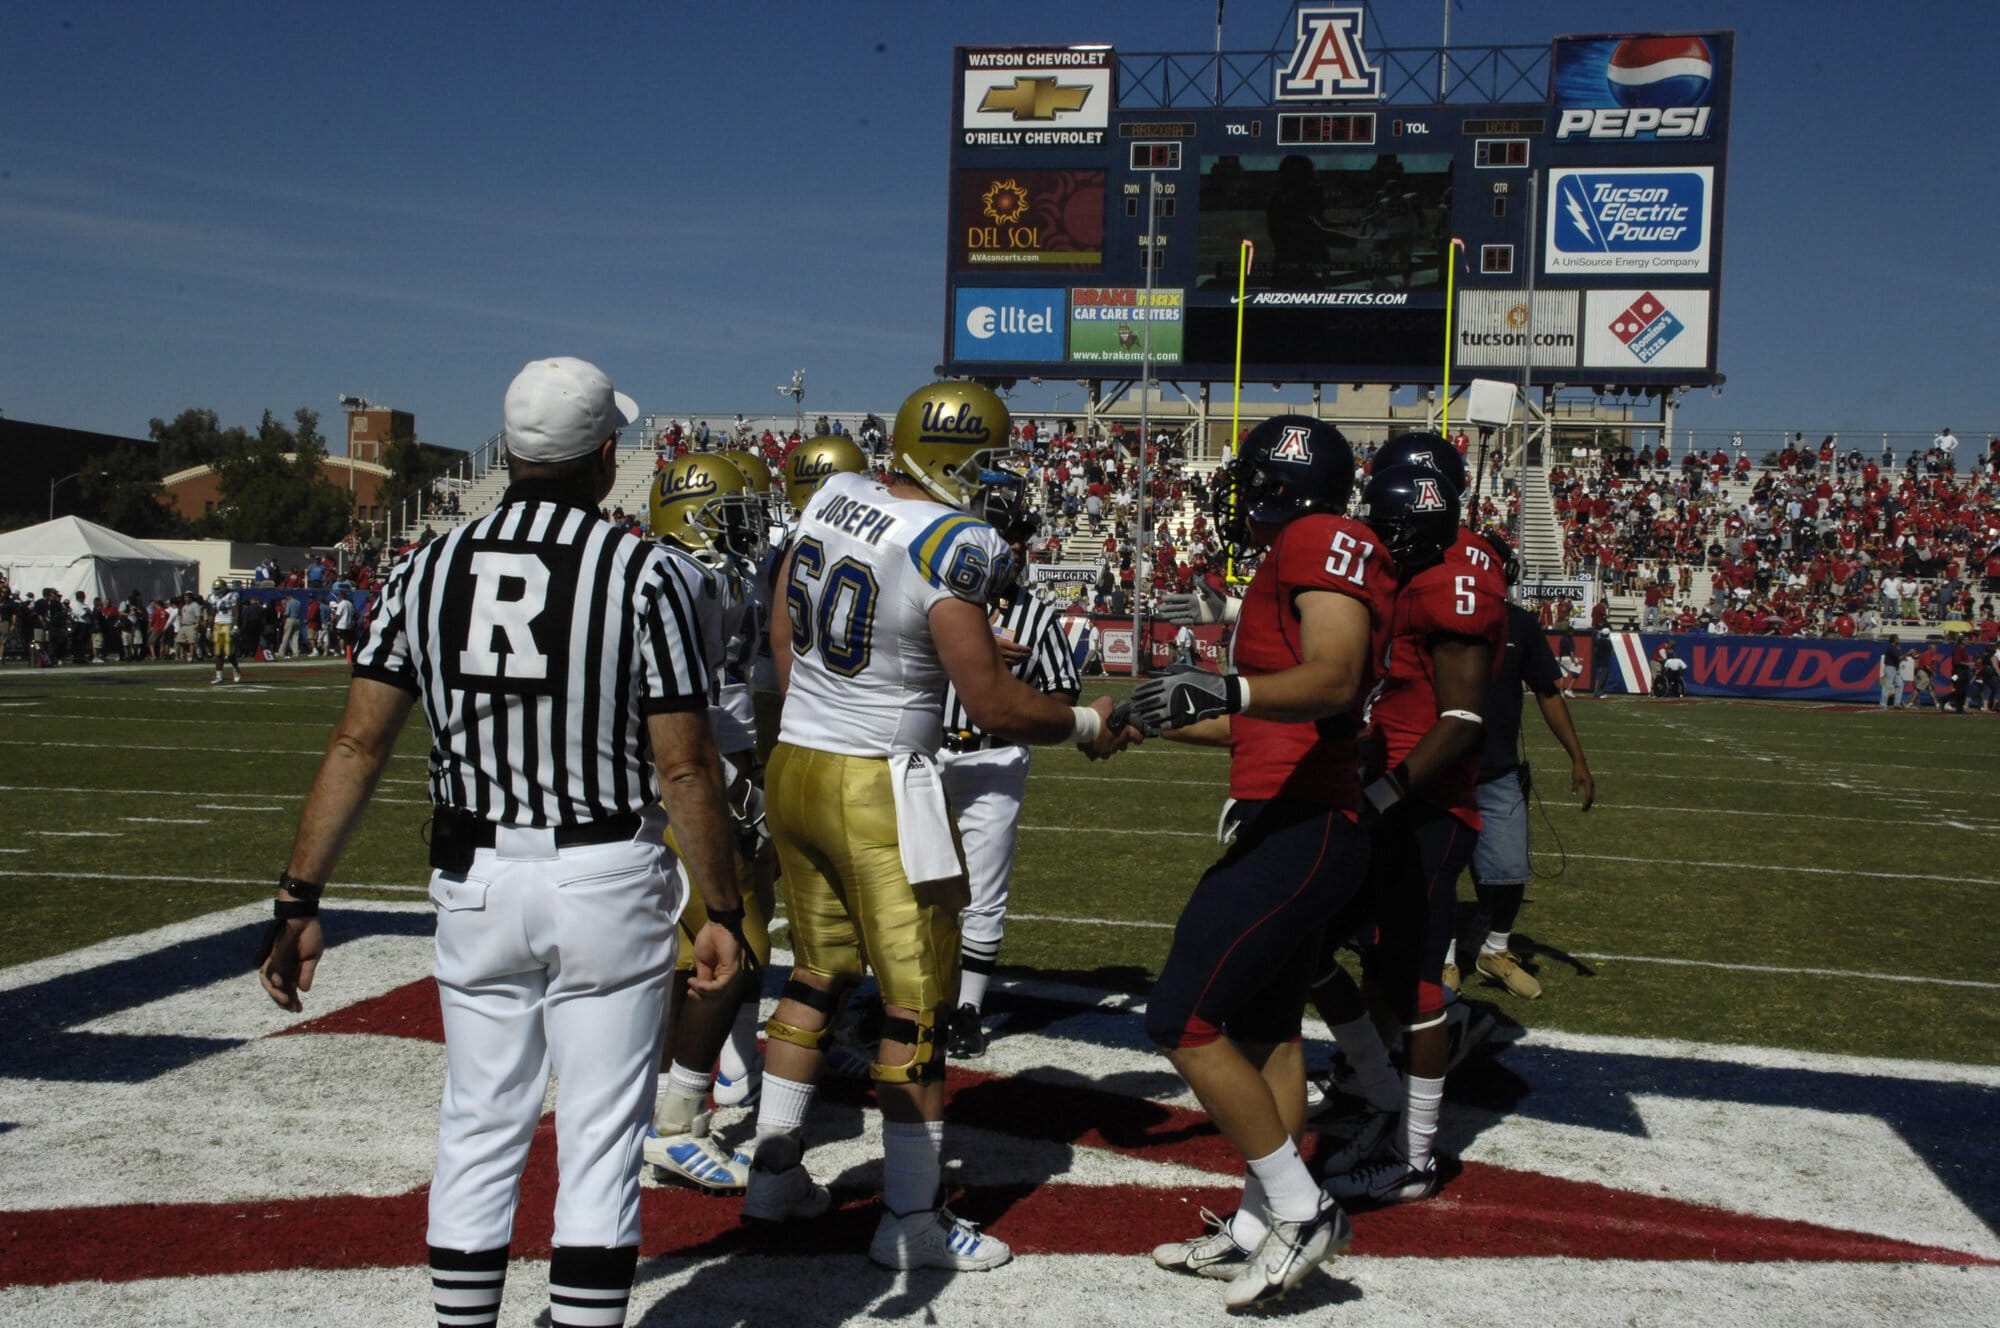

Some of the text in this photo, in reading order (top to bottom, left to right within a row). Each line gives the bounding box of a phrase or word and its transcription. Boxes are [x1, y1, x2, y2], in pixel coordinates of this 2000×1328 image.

[968, 52, 1106, 67] WATSON CHEVROLET
[1275, 8, 1380, 100] A
[1226, 124, 1249, 136] TOL
[1405, 122, 1429, 135] TOL
[1556, 107, 1712, 139] PEPSI
[965, 131, 1104, 145] O'RIELLY CHEVROLET
[1124, 184, 1140, 195] DWN
[1164, 184, 1176, 194] GO
[1592, 182, 1670, 203] Tucson
[1599, 202, 1689, 222] Electric
[968, 226, 1041, 249] DEL SOL
[1138, 235, 1167, 246] BA ON
[1606, 221, 1688, 242] Power
[970, 253, 1040, 262] AVAconcerts.com
[1552, 257, 1700, 270] A UniSource Energy Company
[1252, 291, 1408, 306] ARIZONAATHLETICS.COM
[966, 306, 1054, 339] alltel
[1074, 308, 1097, 320] CAR
[1100, 308, 1129, 320] CARE
[1461, 329, 1575, 347] tucsoncom
[1630, 316, 1672, 353] Domino's
[1638, 337, 1666, 361] Pizza
[1270, 426, 1312, 465] A
[1732, 436, 1742, 446] 29
[1413, 478, 1446, 512] A
[815, 493, 896, 547] JOSEPH
[1325, 530, 1374, 586] 51
[1465, 546, 1490, 571] 77
[1038, 569, 1097, 584] BRUEGGER'S
[1579, 573, 1592, 581] 29
[1454, 575, 1476, 615] 5
[459, 551, 551, 679] R
[1195, 639, 1218, 658] Fa
